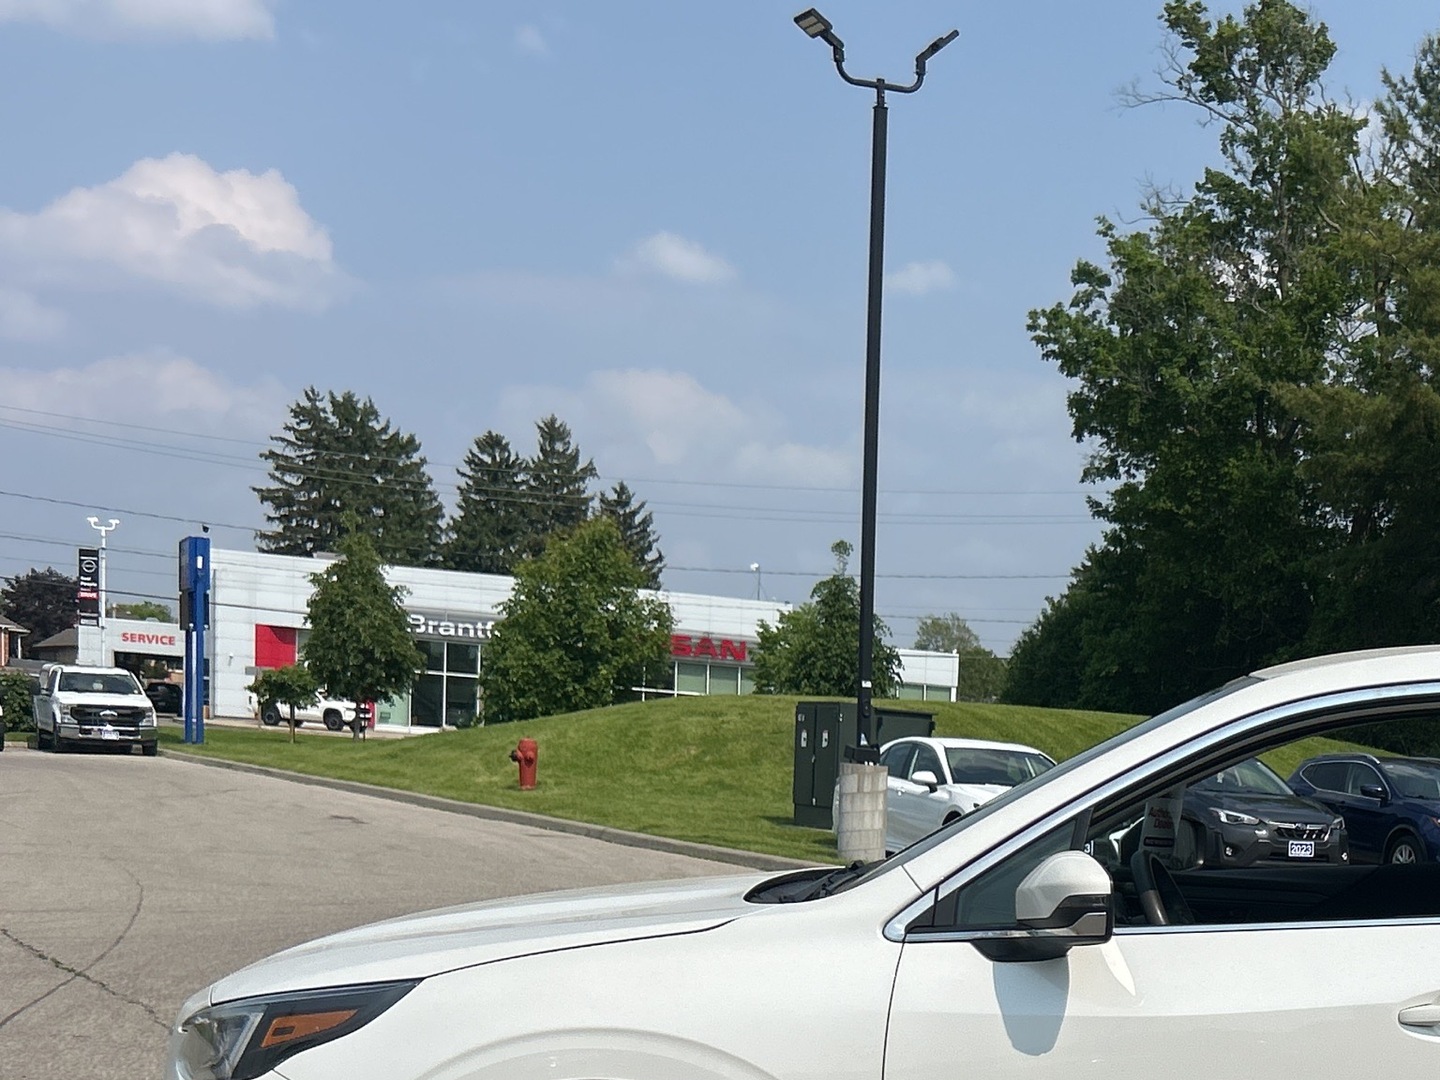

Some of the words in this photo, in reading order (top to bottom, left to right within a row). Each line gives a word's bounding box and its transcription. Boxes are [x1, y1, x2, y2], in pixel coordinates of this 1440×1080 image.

[121, 632, 176, 646] SERVICE
[670, 633, 747, 661] SAN
[1291, 844, 1312, 854] 2023
